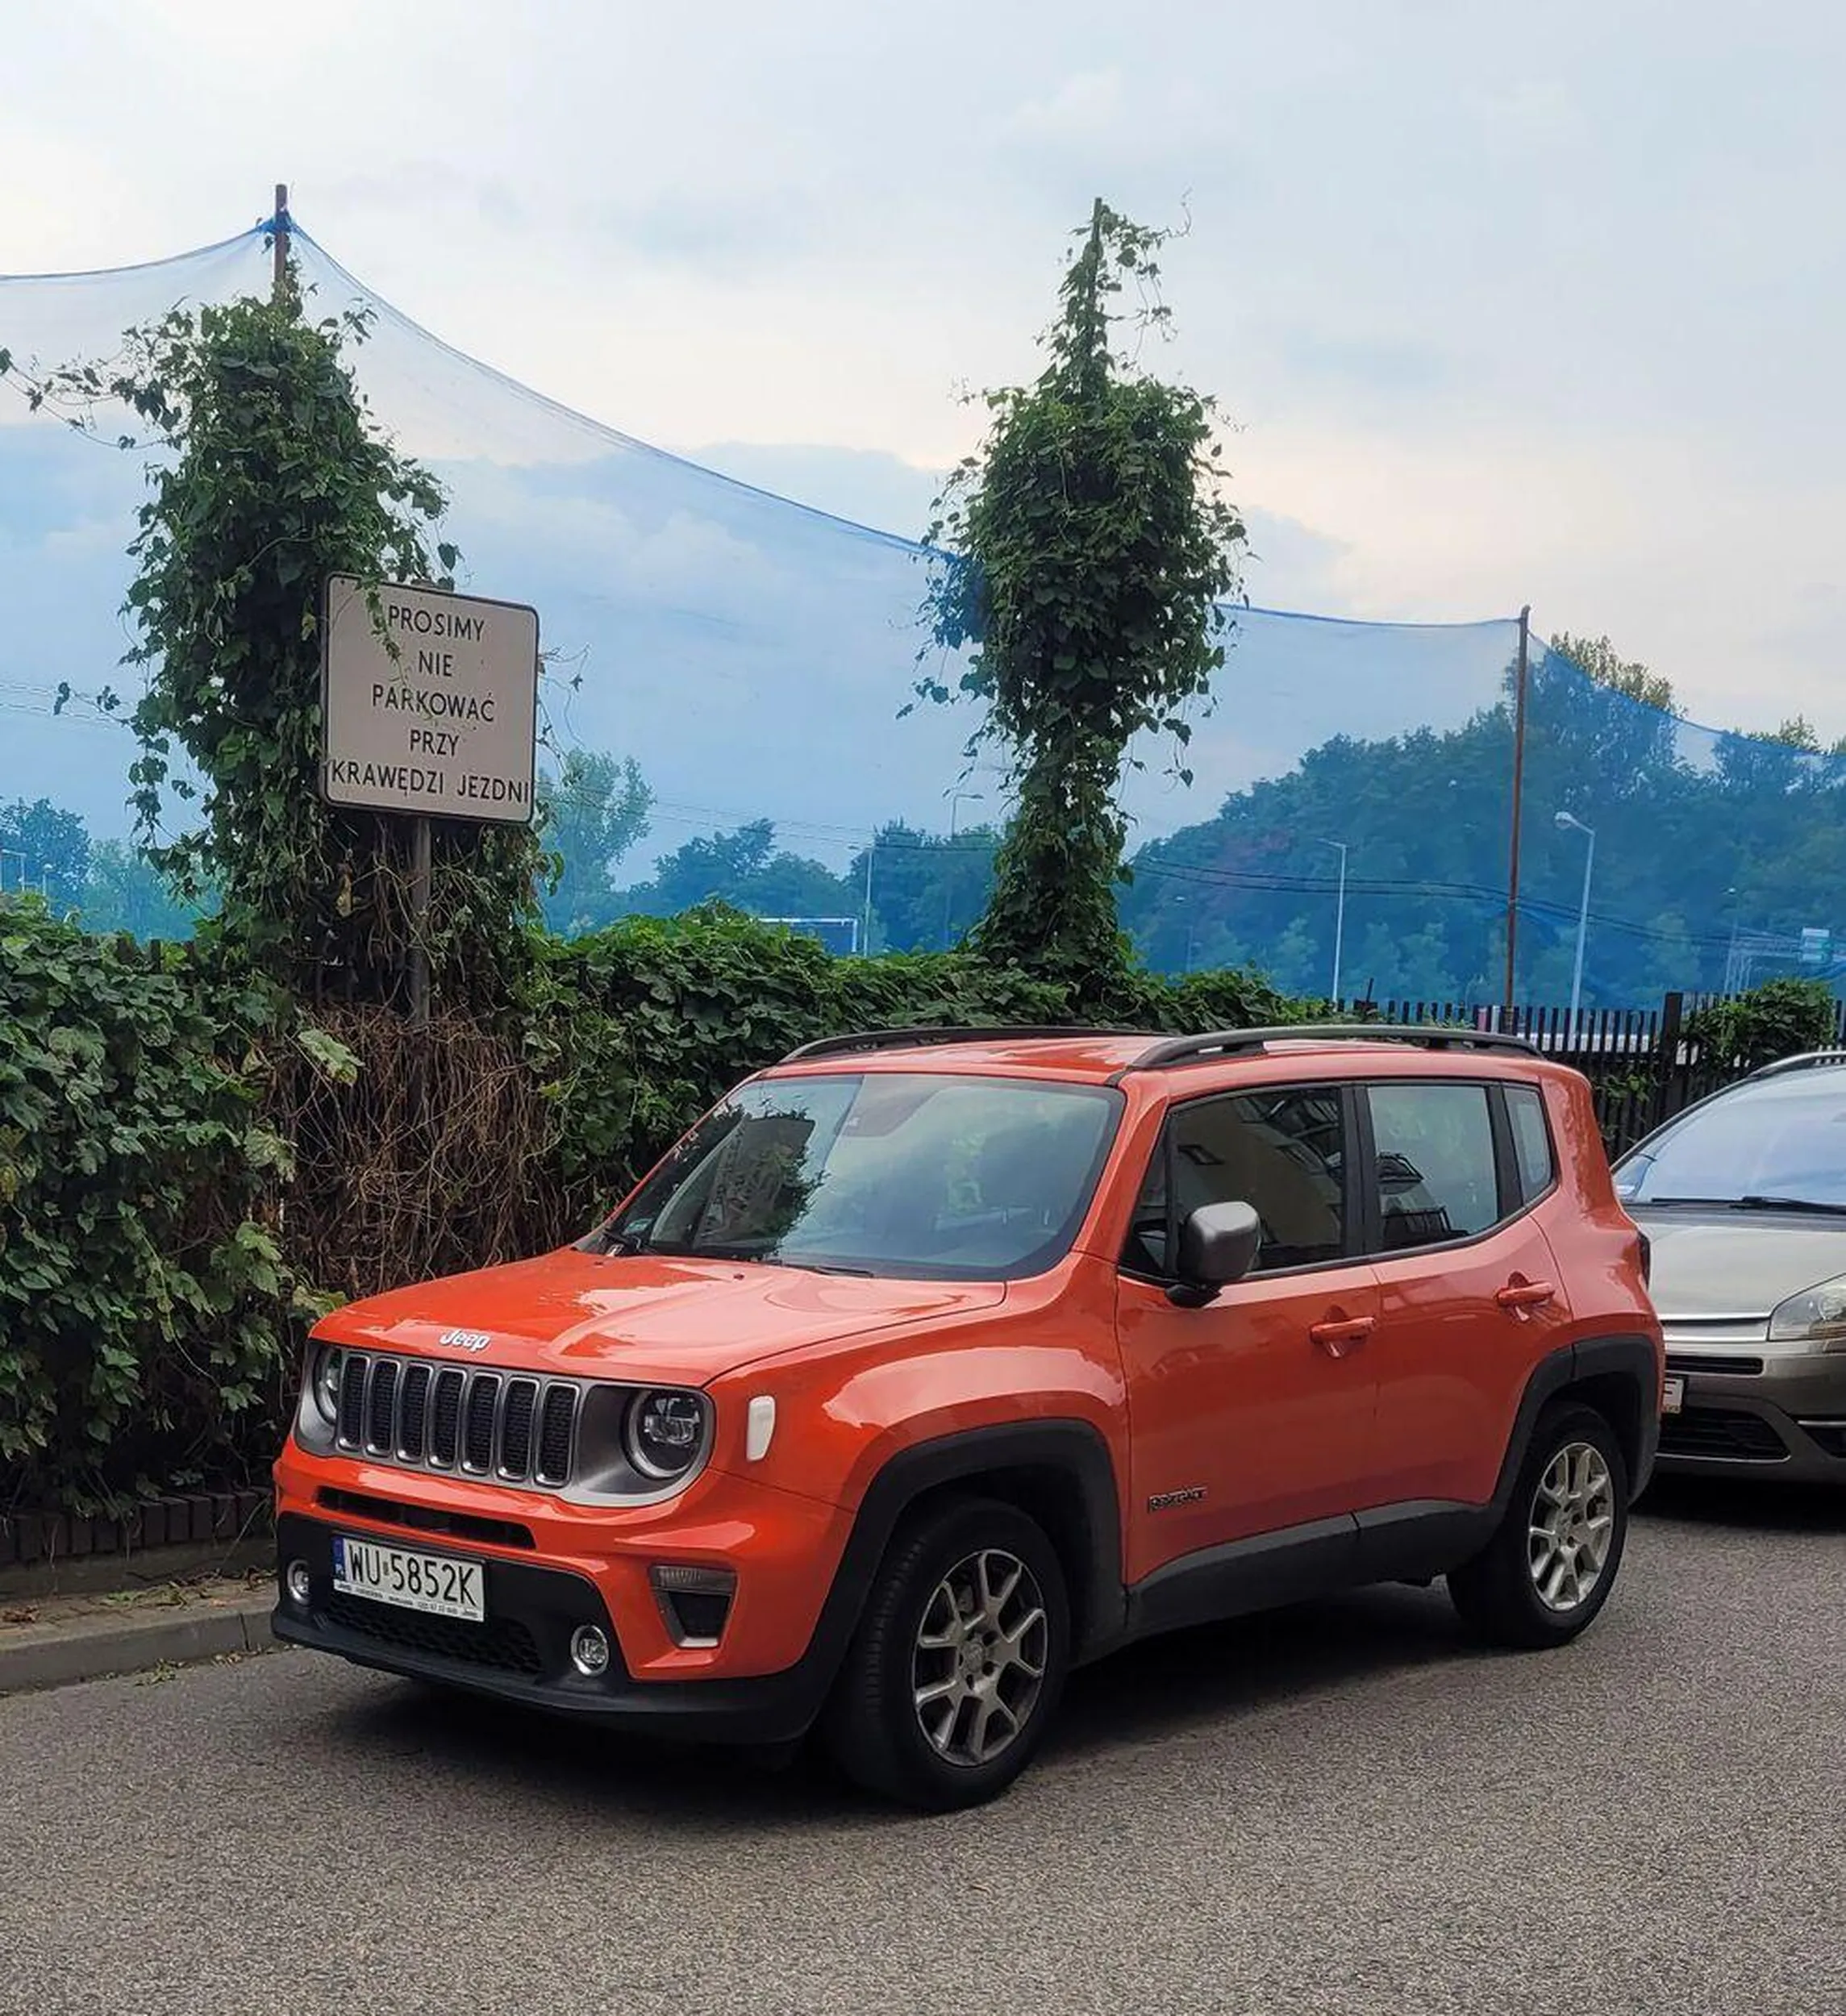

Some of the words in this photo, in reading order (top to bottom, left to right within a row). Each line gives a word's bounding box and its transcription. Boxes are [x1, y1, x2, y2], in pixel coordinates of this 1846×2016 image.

[388, 605, 485, 642] PROSIMY
[418, 650, 453, 677] NIE
[372, 684, 495, 723] PARKOWAĆ
[410, 729, 460, 756] PRZY
[331, 758, 444, 797] KRAWĘDZI
[456, 774, 529, 804] JEZDNI
[439, 1329, 490, 1352] Jeep
[348, 1543, 381, 1585] WU
[390, 1553, 477, 1606] 5852K
